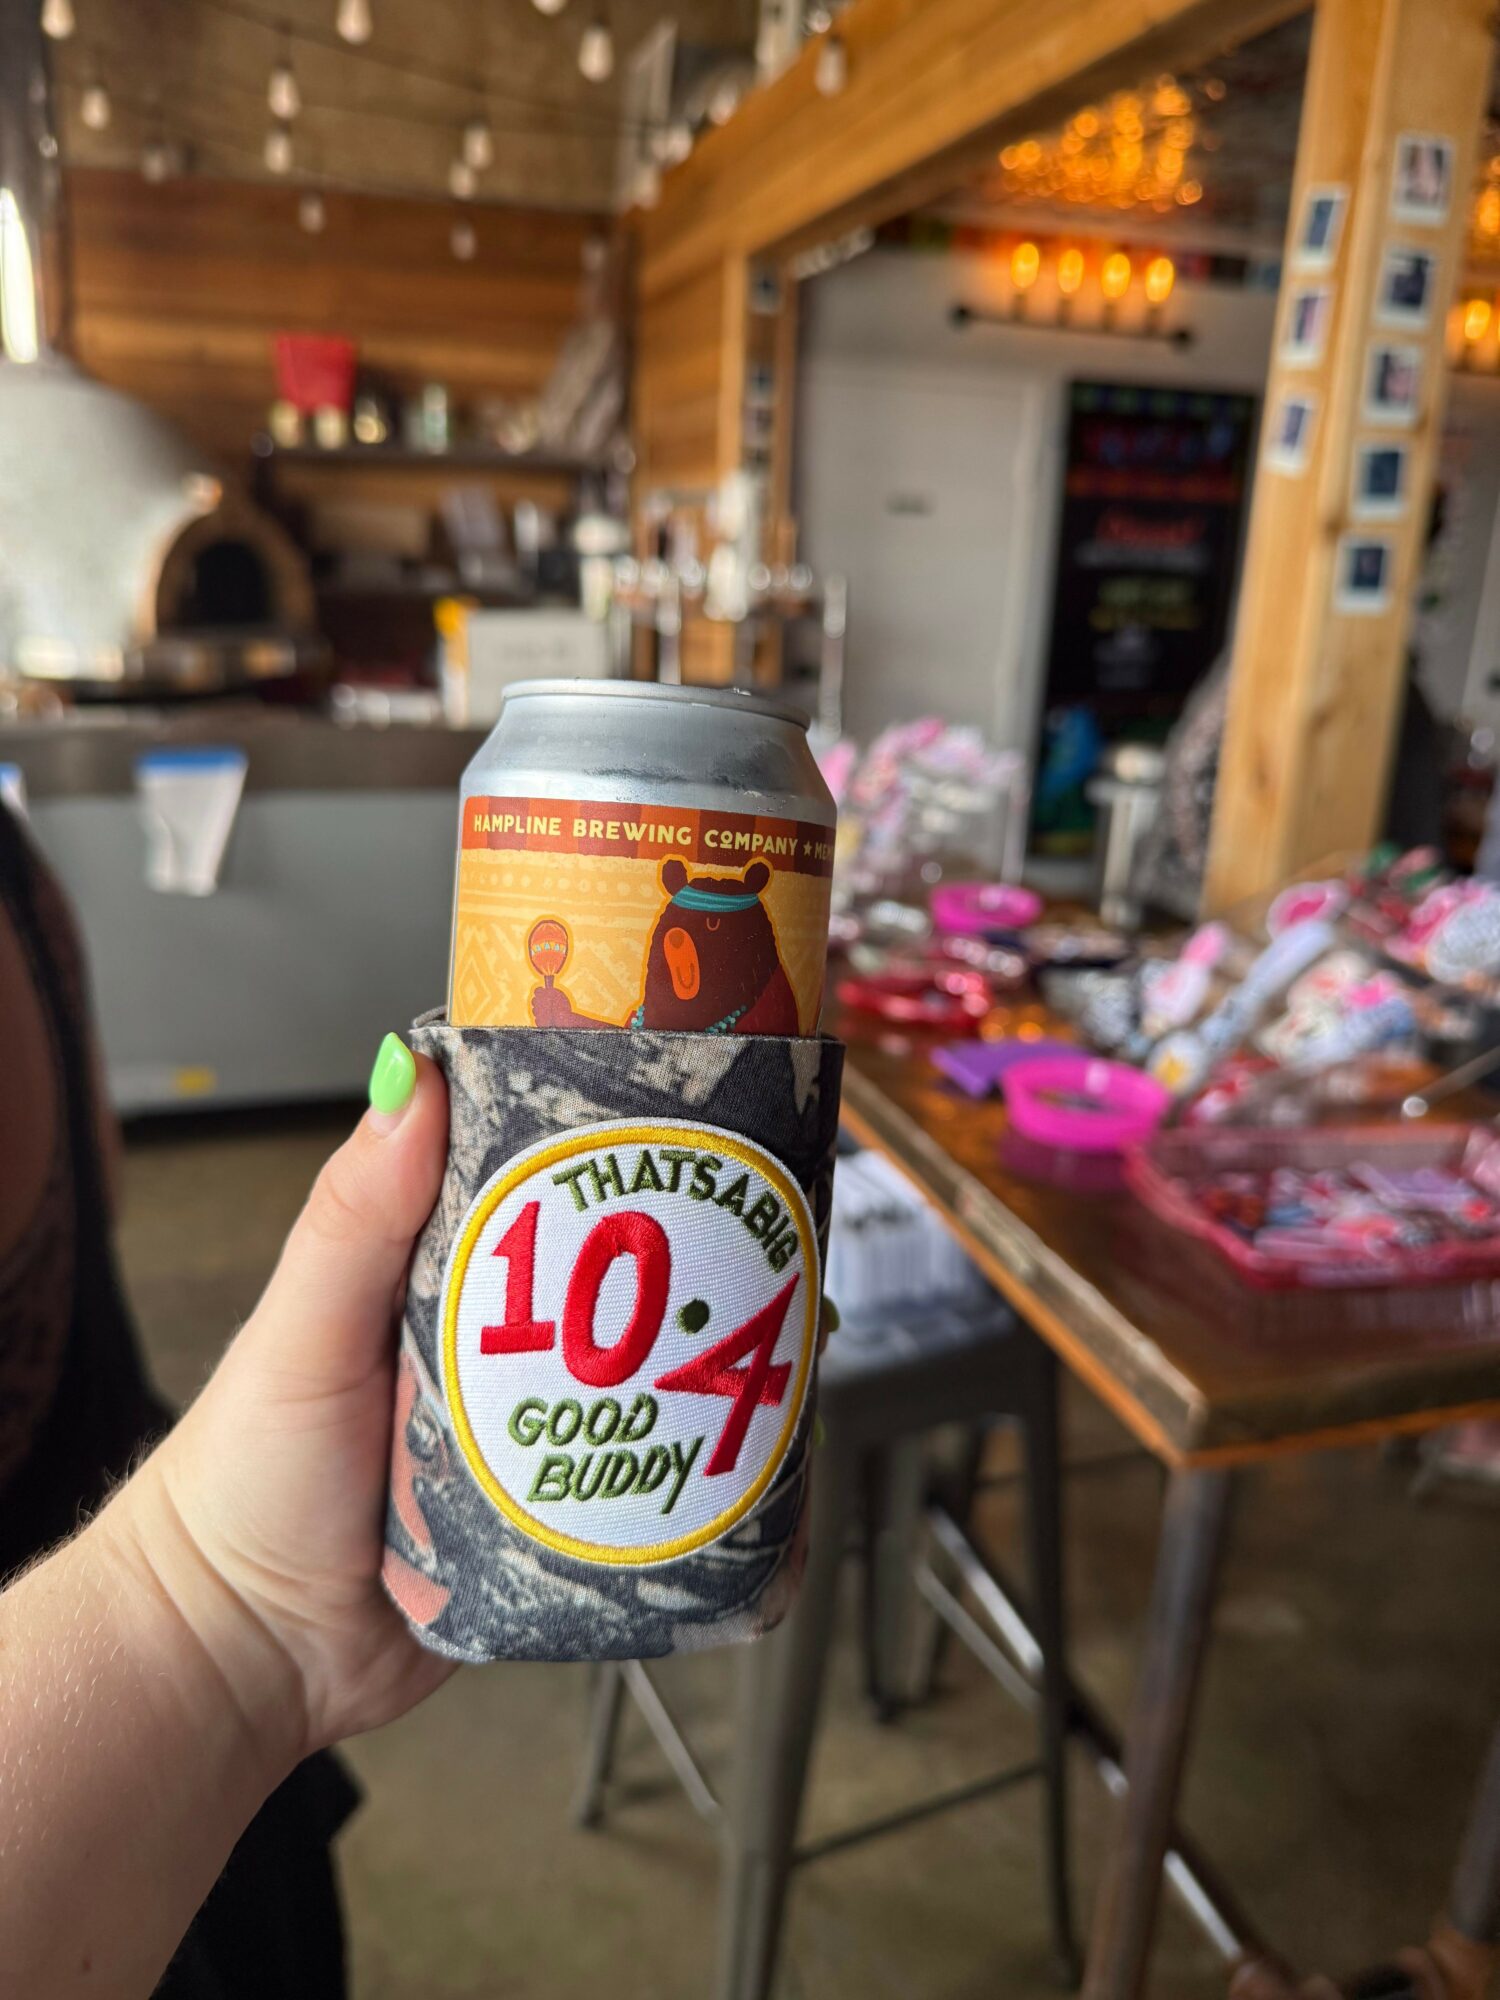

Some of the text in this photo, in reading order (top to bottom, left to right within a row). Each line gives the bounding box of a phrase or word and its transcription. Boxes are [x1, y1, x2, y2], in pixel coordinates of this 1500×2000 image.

[474, 814, 562, 836] HAMPLINE
[573, 818, 692, 845] BREWING
[704, 829, 798, 856] COMPANY
[507, 1394, 658, 1446] GOOD
[527, 1436, 704, 1515] BUDDY
